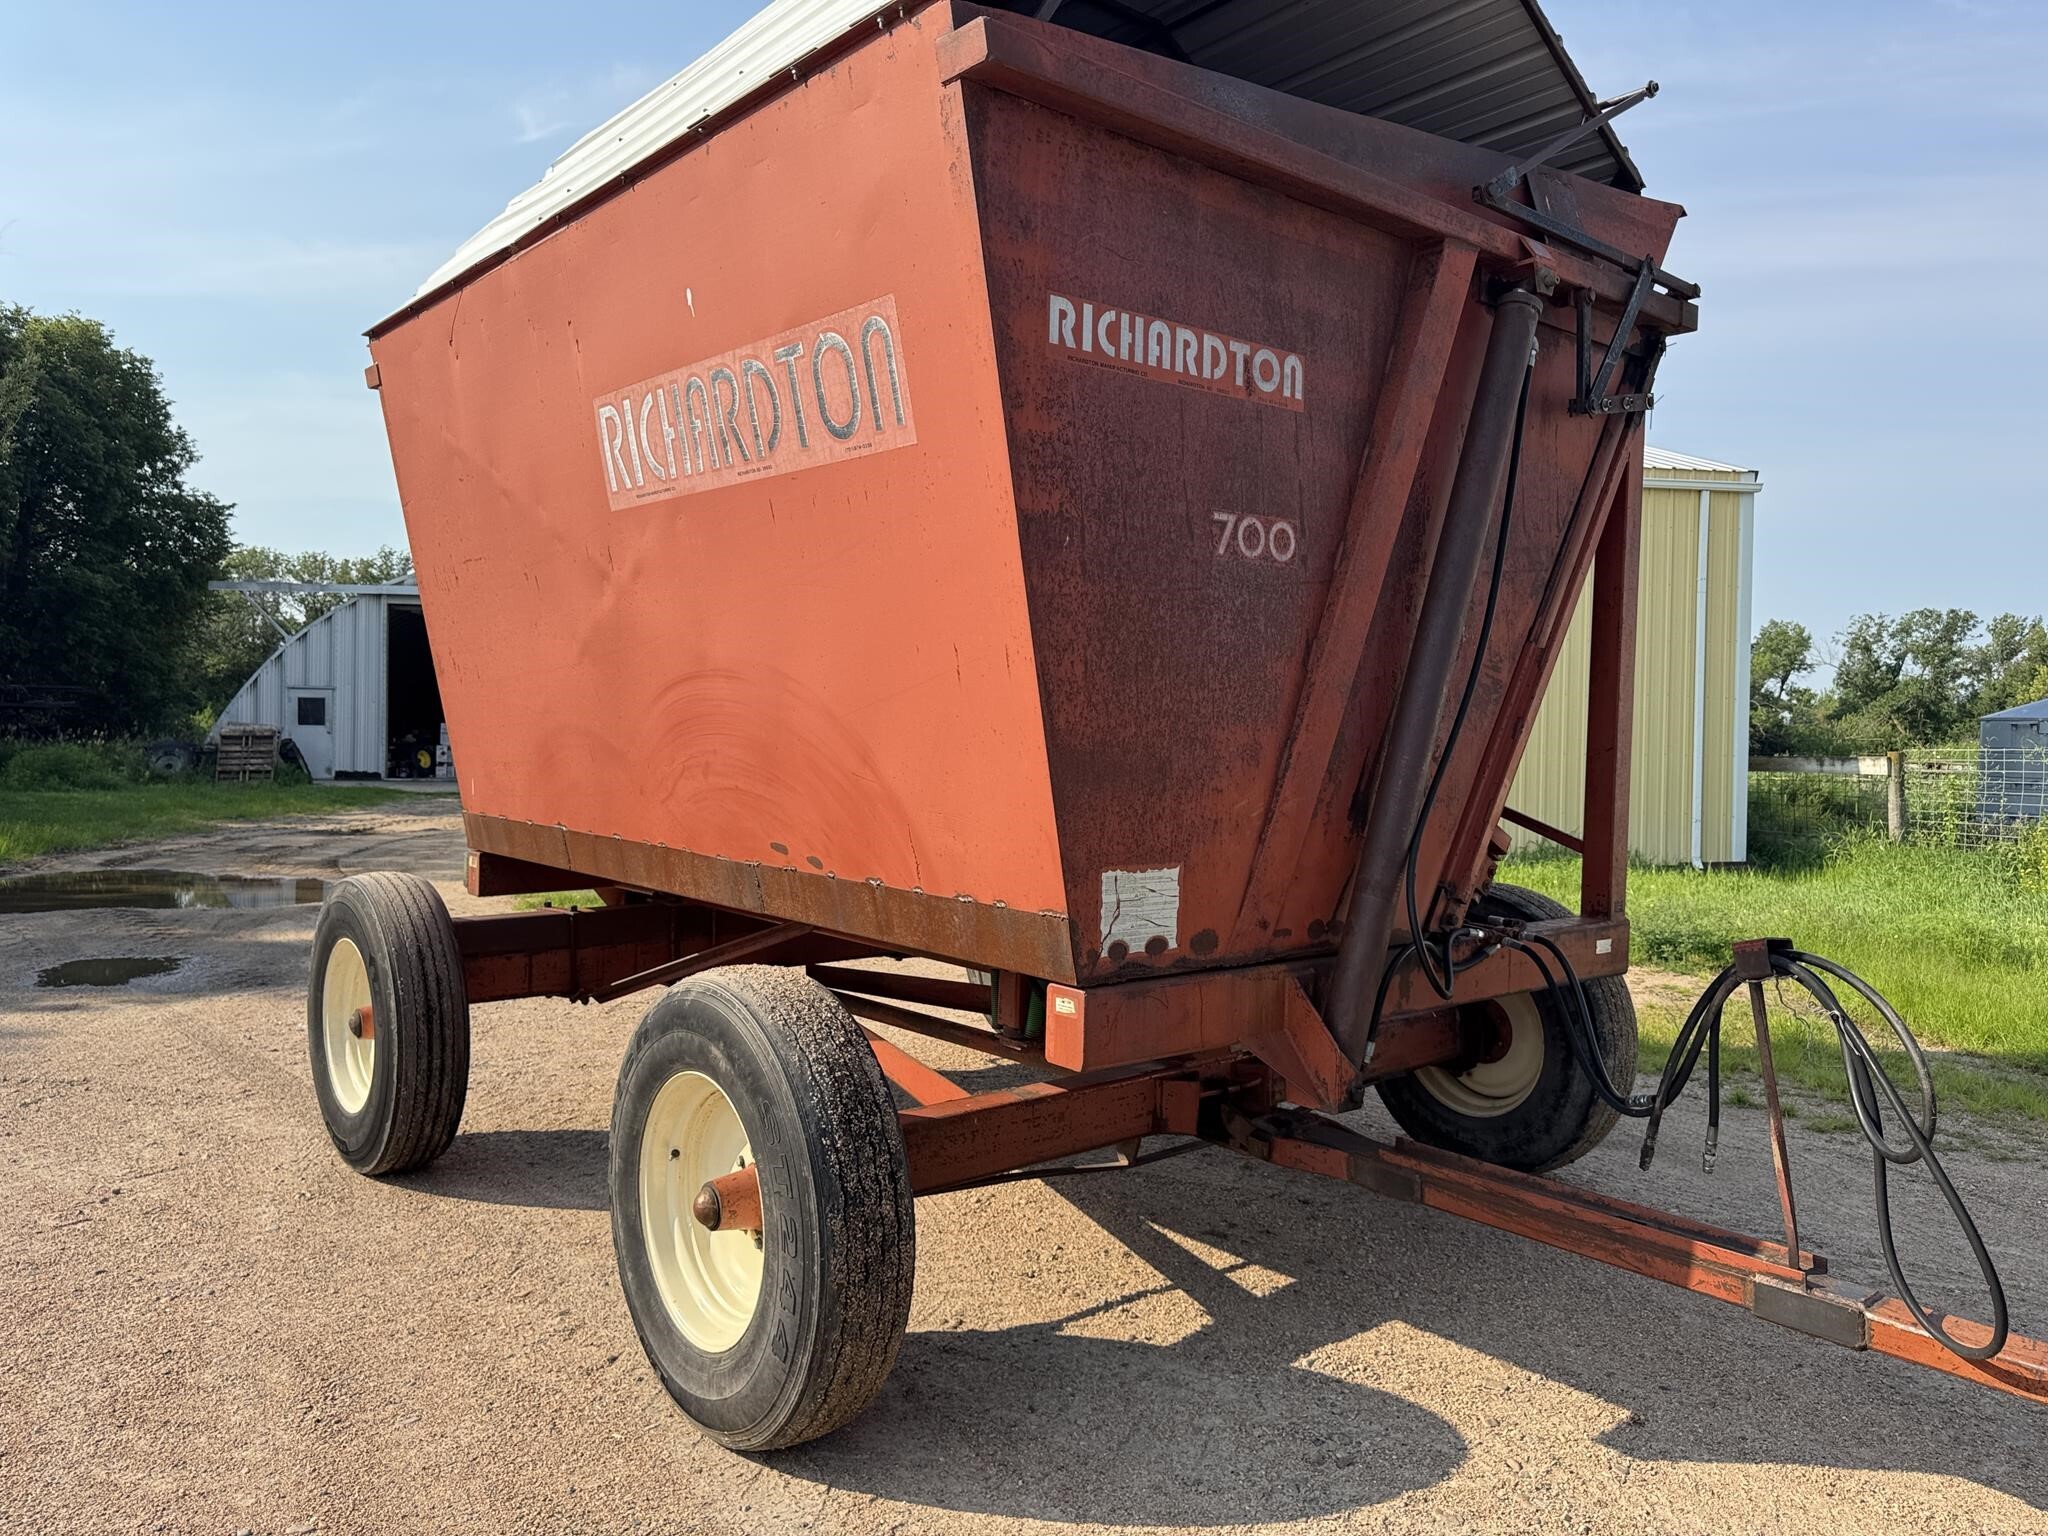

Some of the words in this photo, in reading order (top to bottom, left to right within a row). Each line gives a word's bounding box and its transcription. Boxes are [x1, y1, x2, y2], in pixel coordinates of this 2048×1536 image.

[1049, 294, 1303, 400] RICHARDTON
[599, 315, 905, 492] RICHARDTON
[1213, 511, 1296, 562] 700
